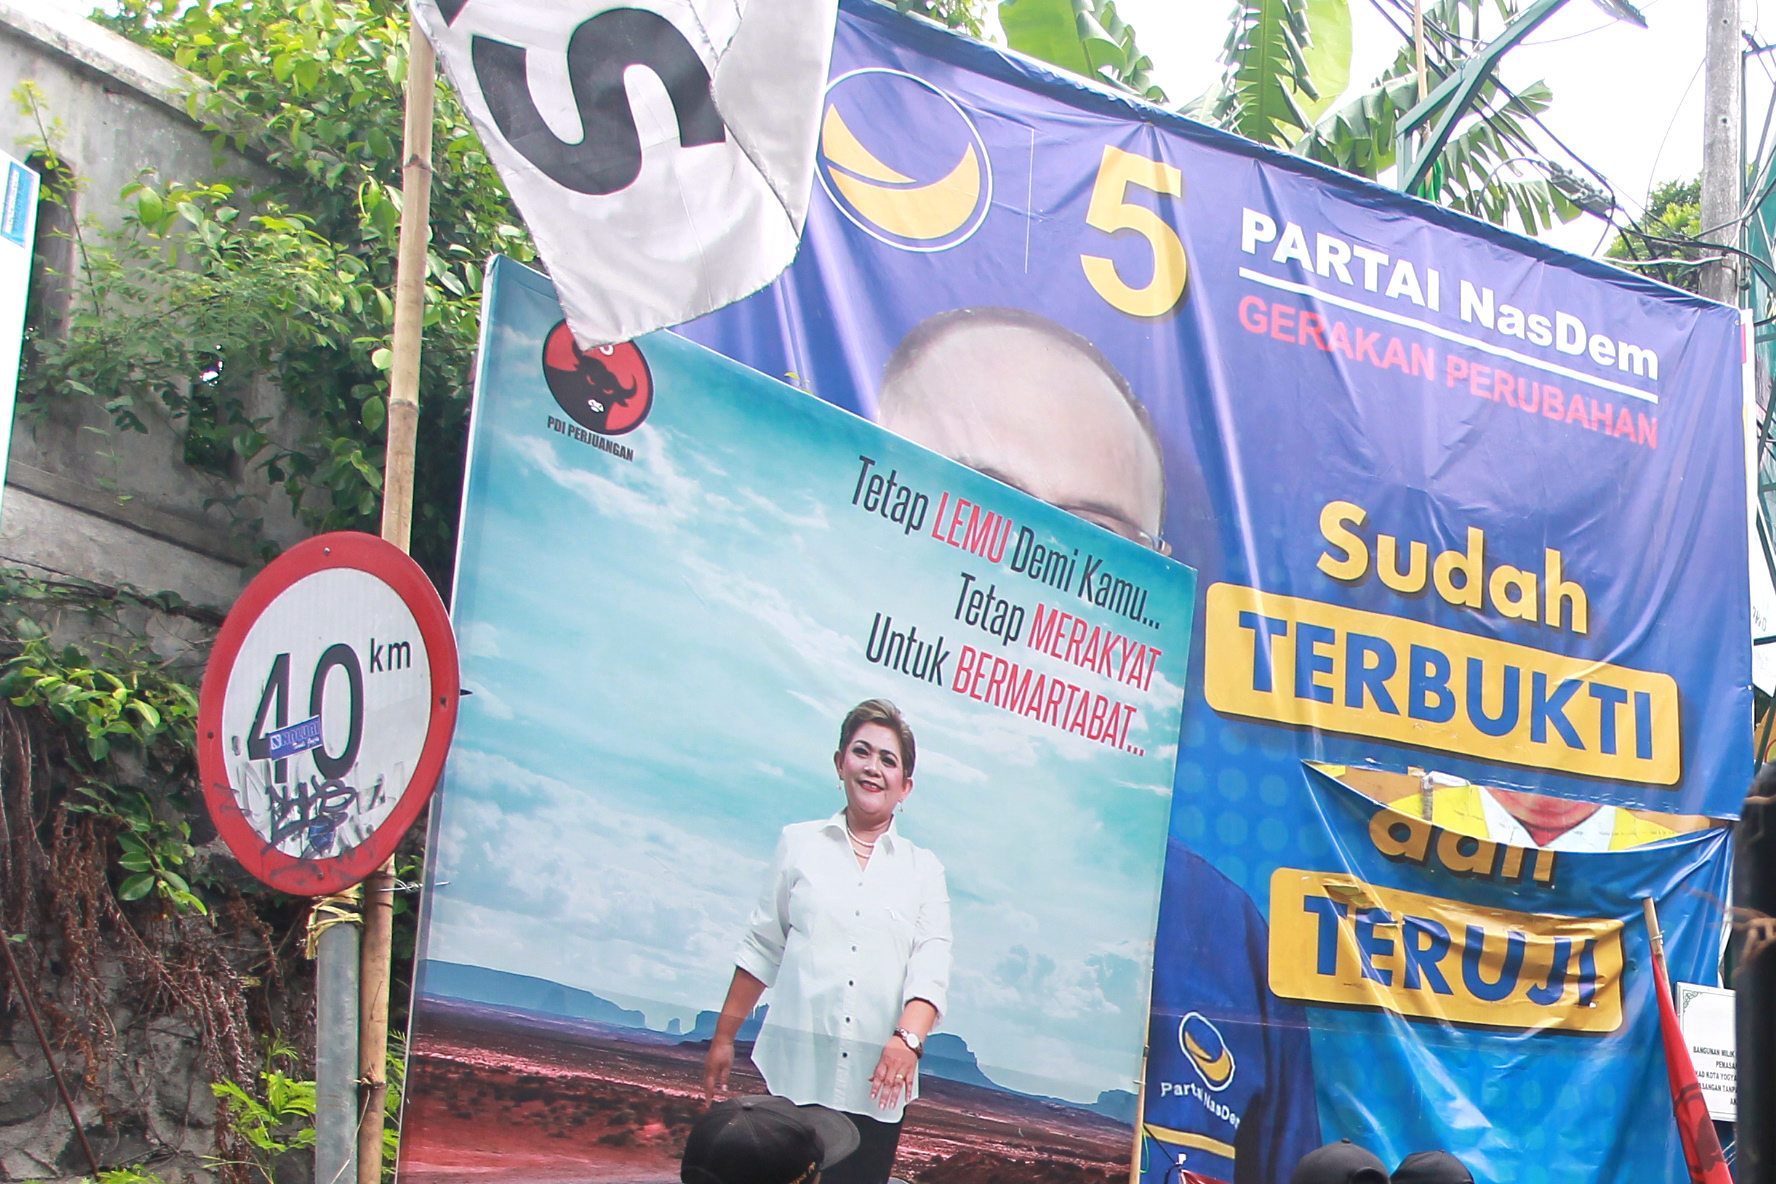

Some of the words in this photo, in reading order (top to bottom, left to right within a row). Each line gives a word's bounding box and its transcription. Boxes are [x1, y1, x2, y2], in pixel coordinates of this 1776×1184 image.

[1080, 144, 1188, 318] 5
[1241, 206, 1440, 312] PARTAI
[1460, 279, 1660, 381] NasDem
[547, 415, 566, 434] PDI
[568, 424, 634, 462] PERJUANGAN
[1238, 294, 1436, 382] GERAKAN
[1446, 353, 1659, 450] PERUBAHAN
[852, 454, 929, 536] Tetap
[931, 491, 1014, 564] LEMU
[1010, 525, 1079, 593] Demi
[1078, 553, 1162, 630] Kamu...
[1316, 499, 1589, 634] Sudah
[865, 612, 951, 687] Untuk
[952, 644, 1146, 758] BERMARTABAT...
[954, 571, 1025, 647] Tetap
[1026, 602, 1163, 693] MERAKYAT
[1238, 610, 1655, 761] TERBUKTI
[247, 643, 364, 784] 40
[369, 637, 412, 674] km
[1304, 894, 1598, 1007] TERUJI
